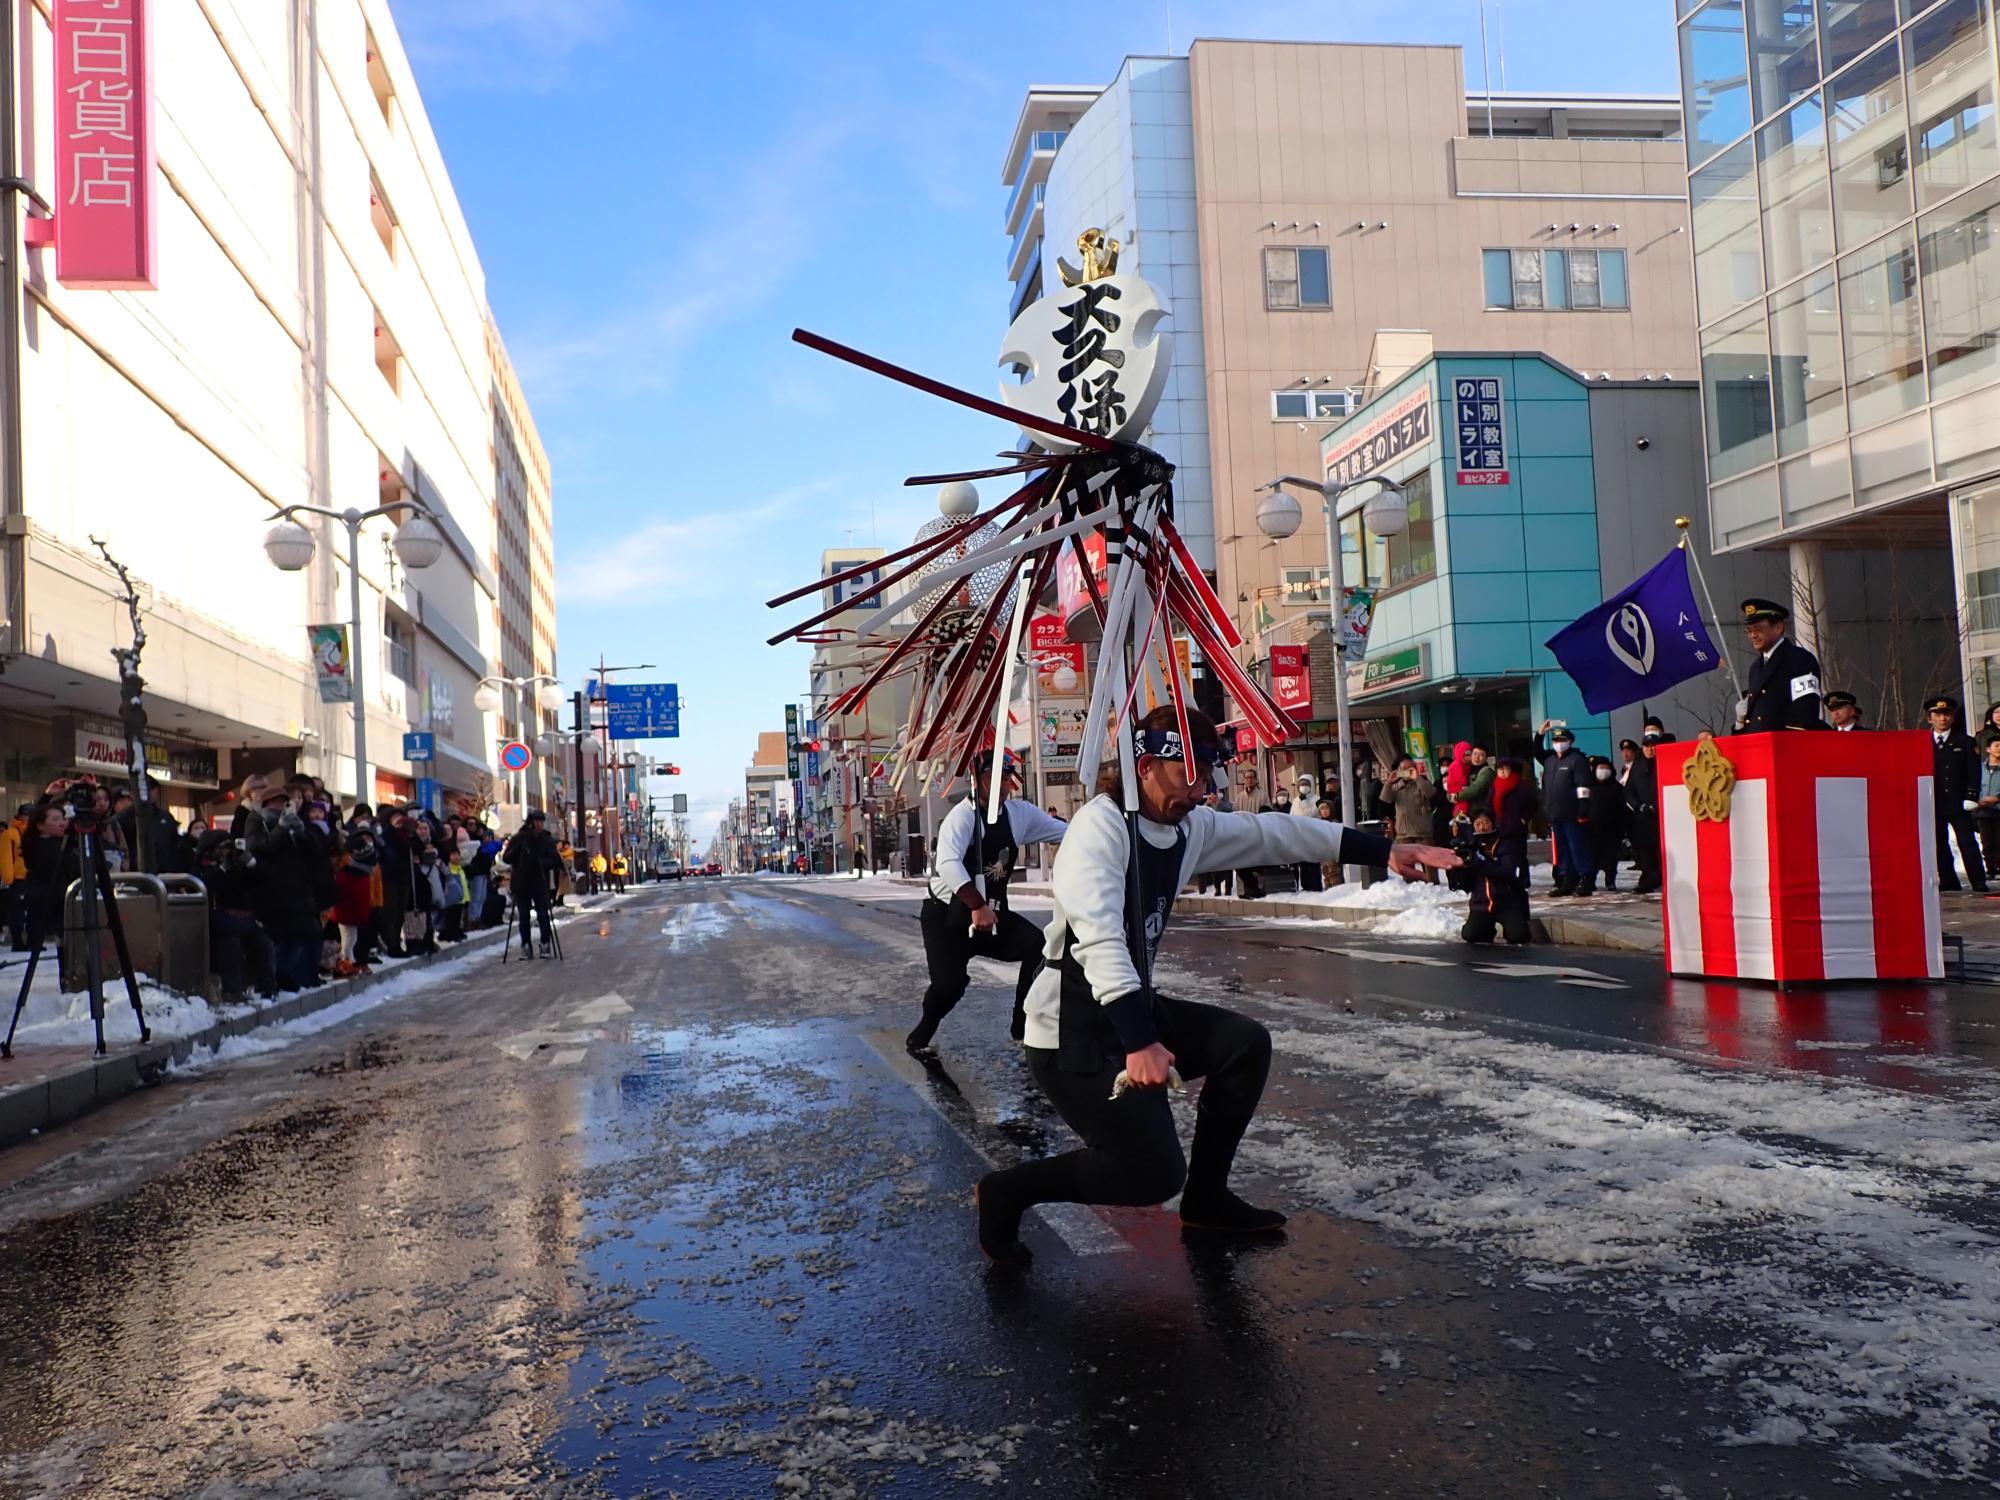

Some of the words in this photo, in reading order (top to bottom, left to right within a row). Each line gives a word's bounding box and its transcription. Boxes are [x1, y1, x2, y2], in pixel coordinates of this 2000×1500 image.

[65, 0, 134, 207] 百貨店
[1459, 382, 1478, 467] のトライ
[1480, 382, 1502, 467] 個別教室
[414, 735, 420, 749] 1
